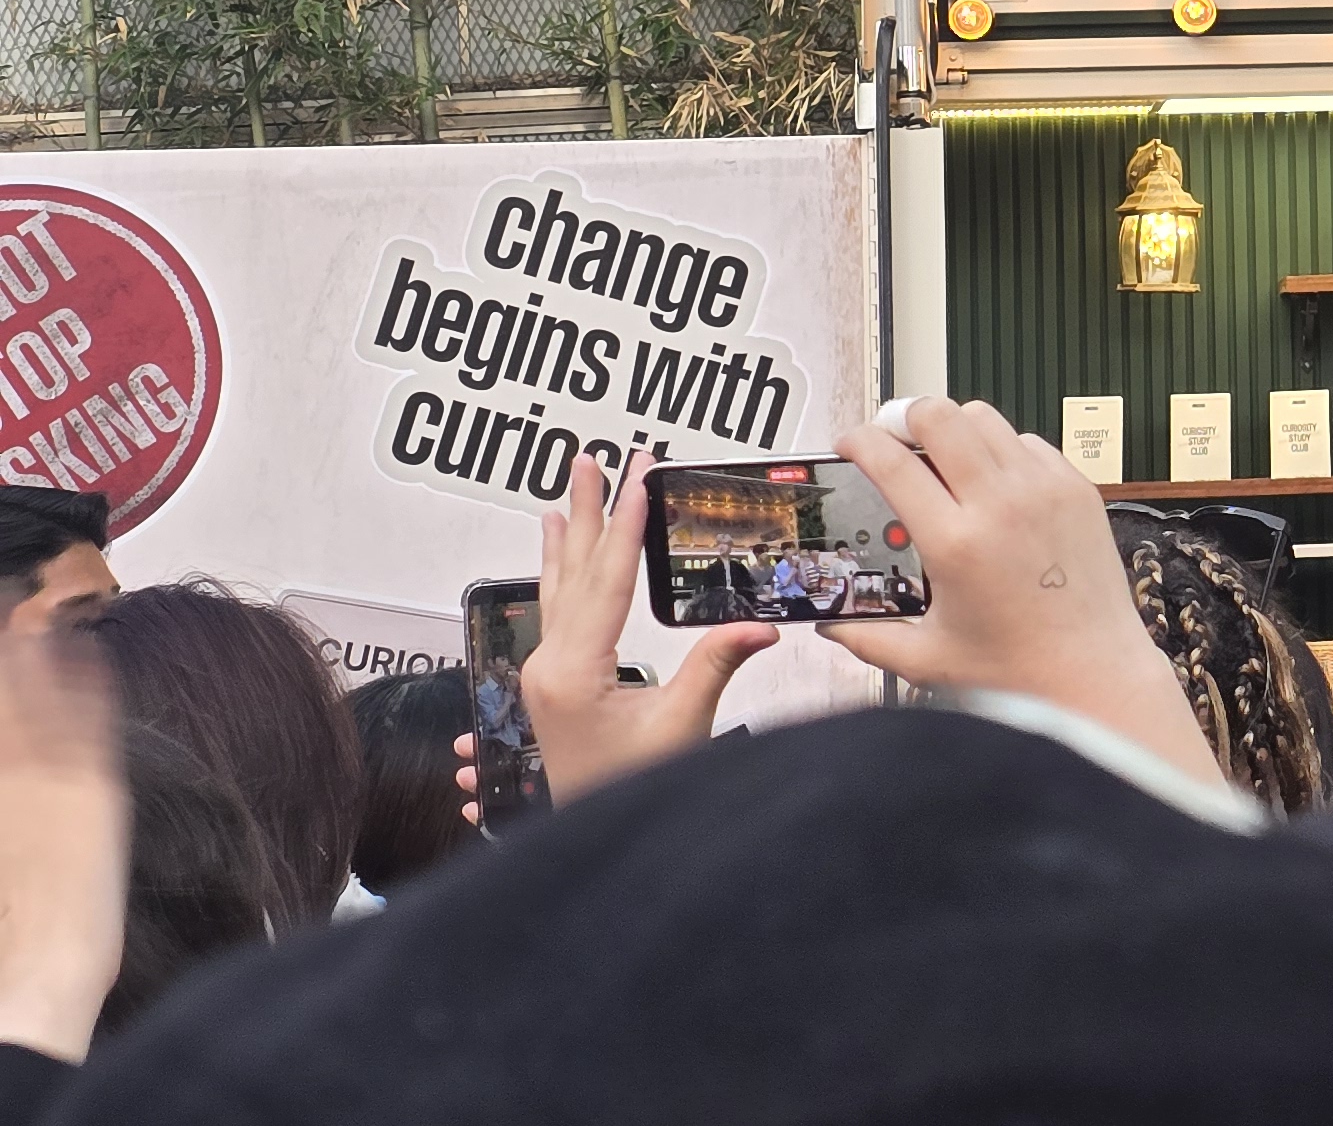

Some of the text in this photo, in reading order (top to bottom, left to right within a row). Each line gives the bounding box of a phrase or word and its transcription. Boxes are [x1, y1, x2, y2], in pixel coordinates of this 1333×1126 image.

[0, 211, 77, 322] OT
[483, 188, 749, 333] change
[374, 257, 790, 451] begins with
[0, 363, 192, 492] SKING
